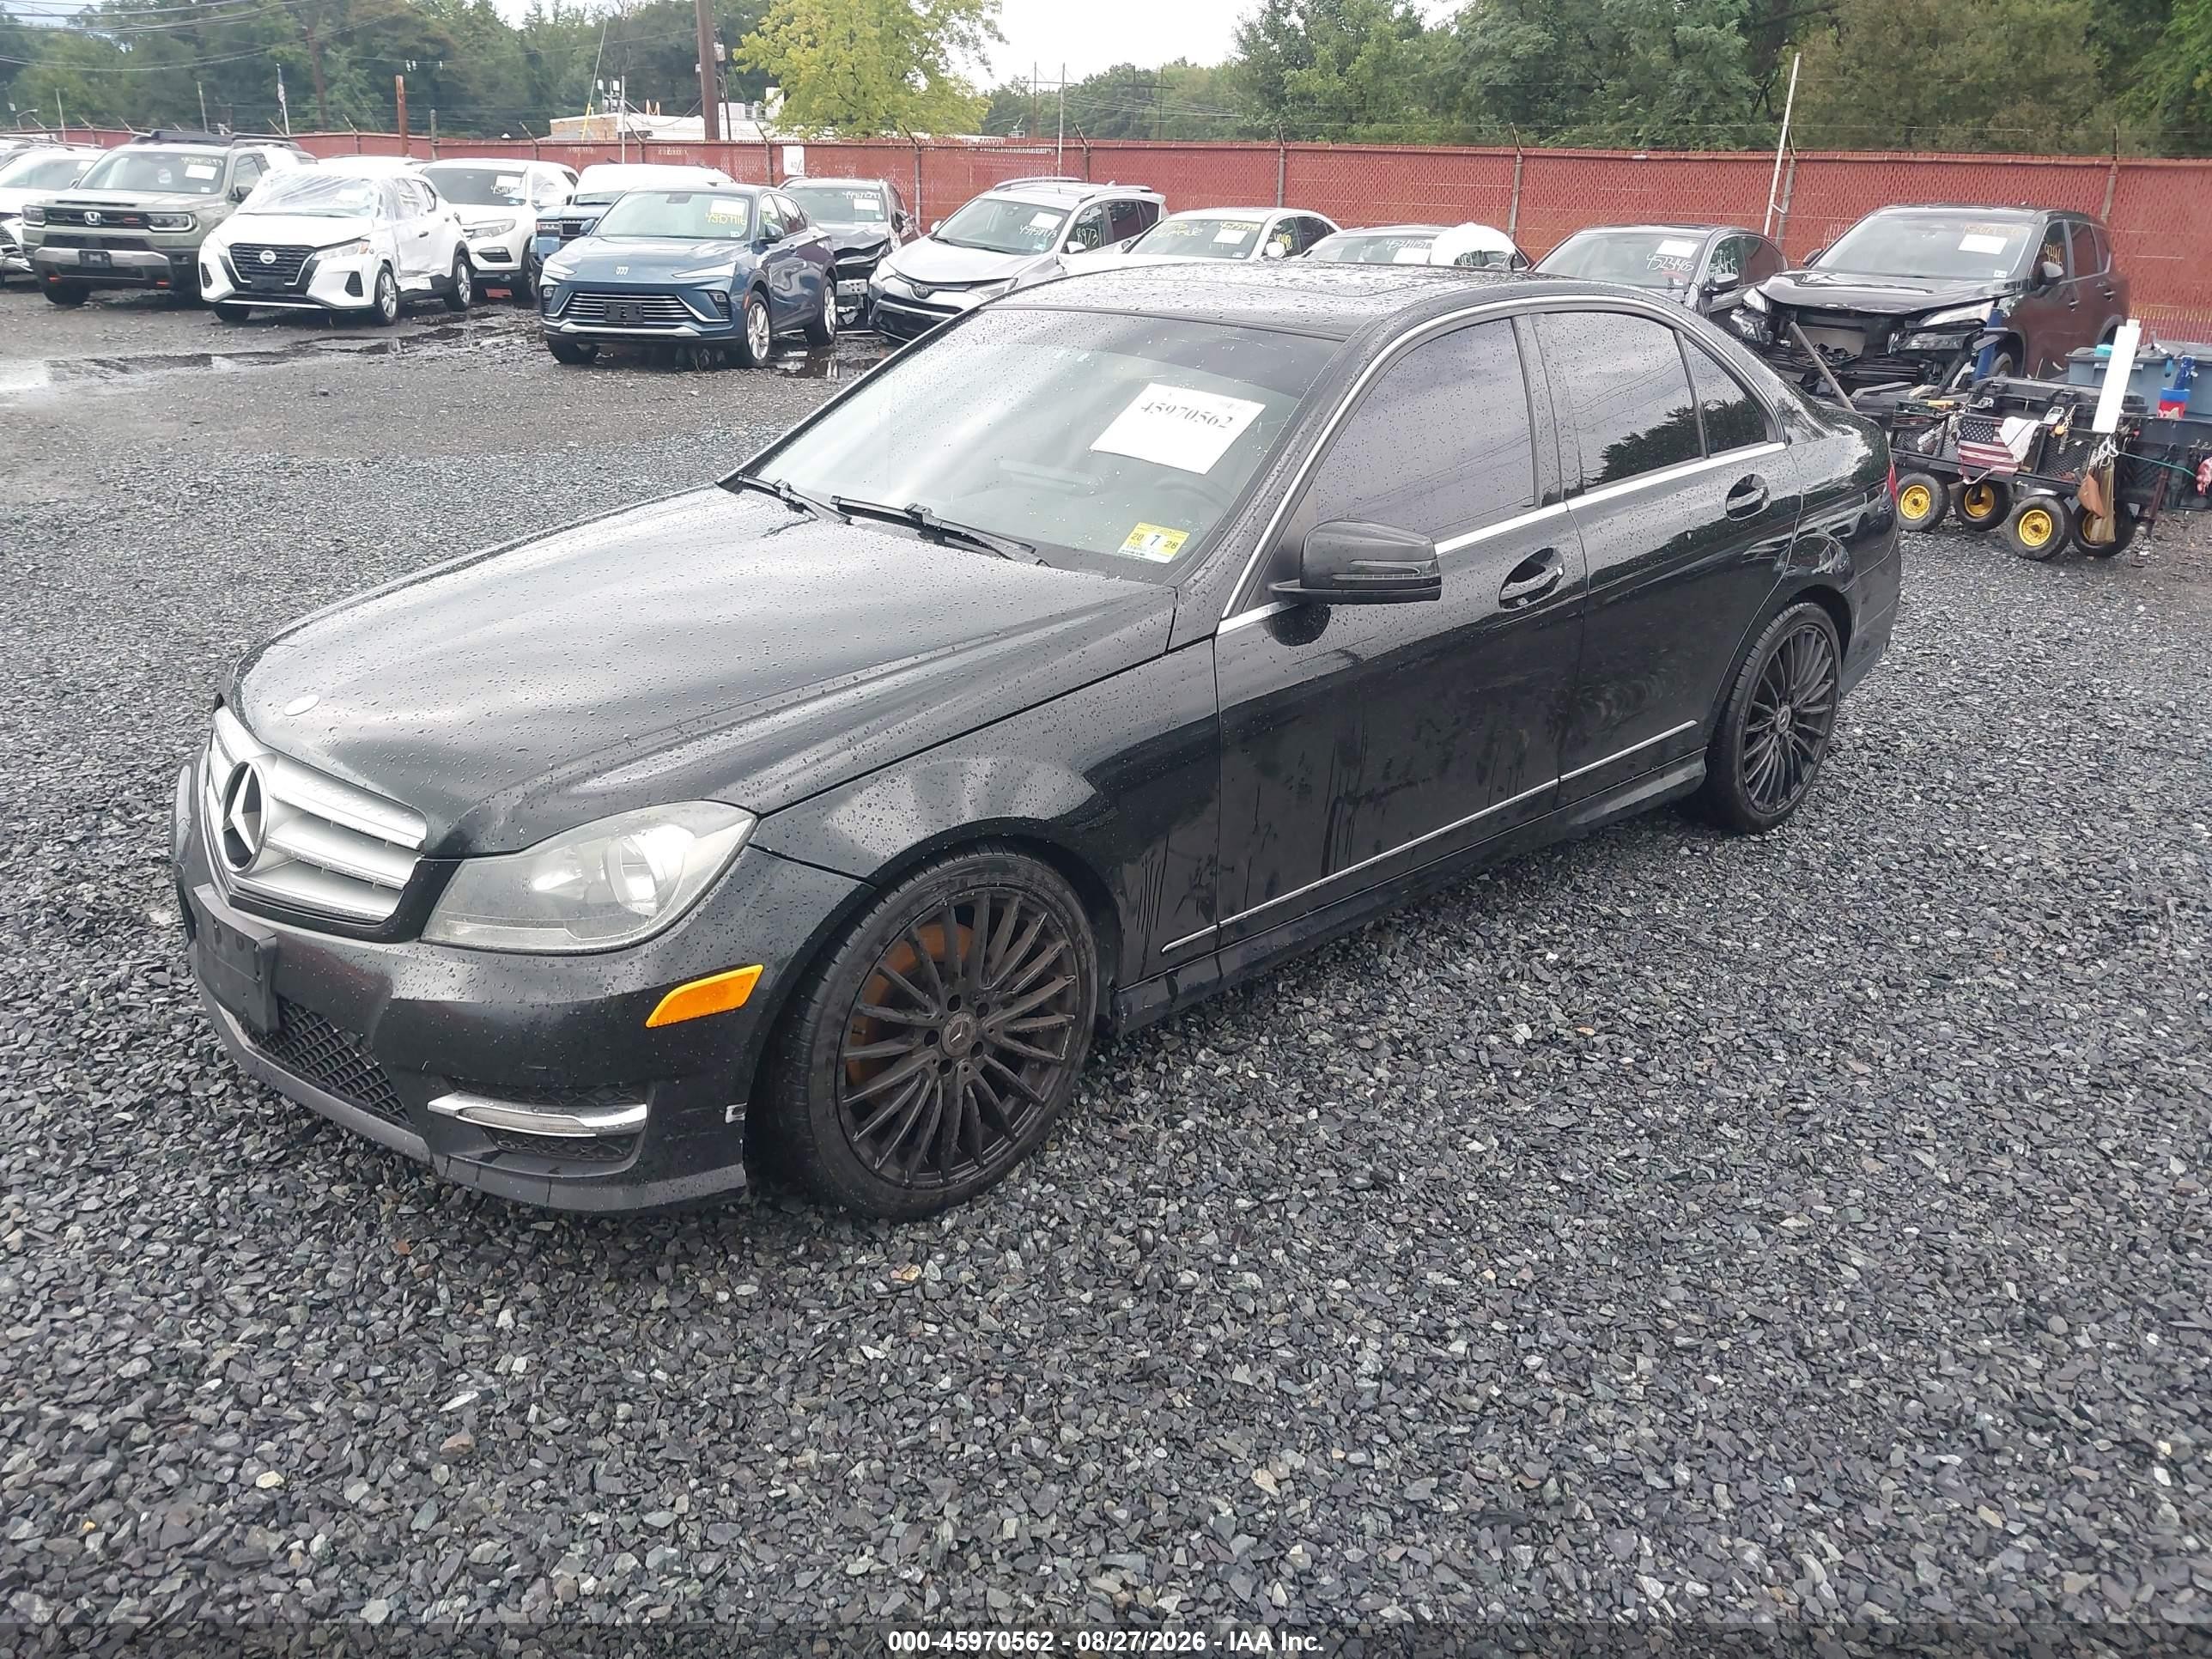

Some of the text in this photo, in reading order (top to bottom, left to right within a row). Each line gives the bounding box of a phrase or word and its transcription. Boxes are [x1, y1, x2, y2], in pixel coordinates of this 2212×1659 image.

[1140, 401, 1234, 428] 45970562
[1131, 532, 1179, 550] 20 7 28
